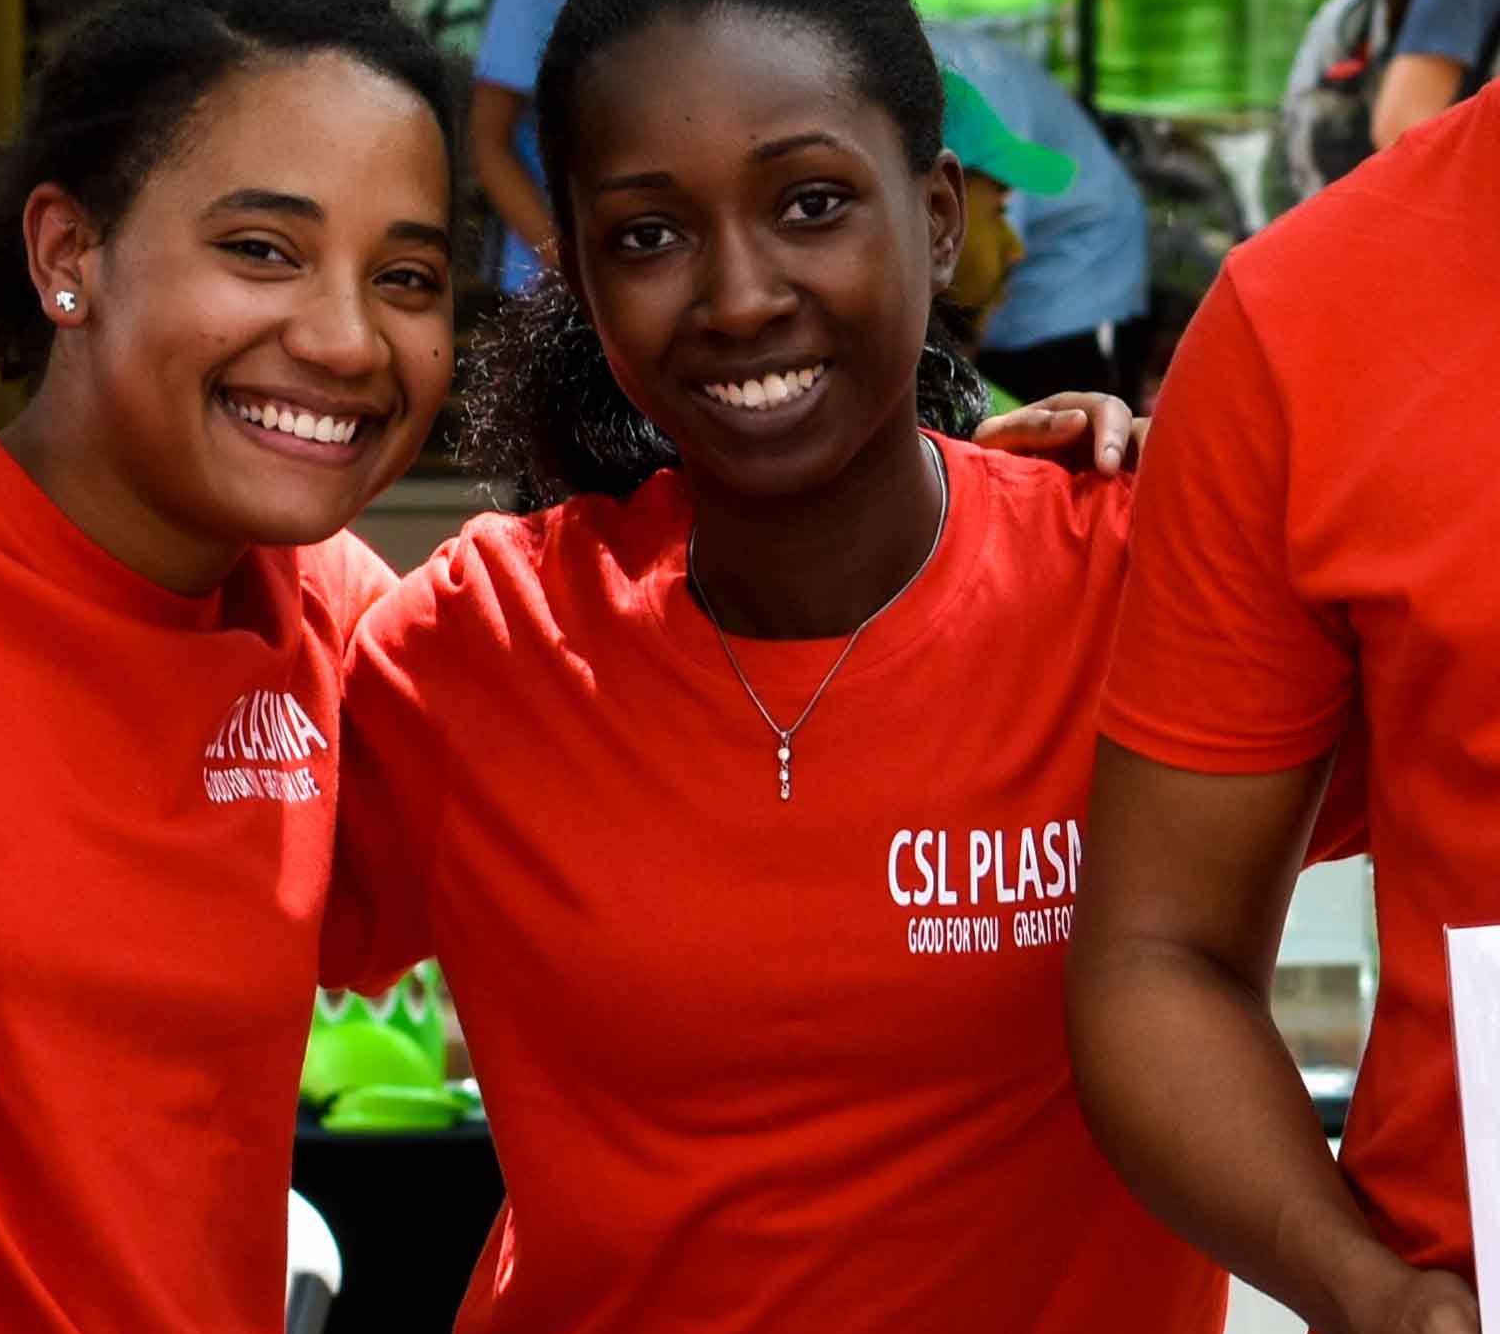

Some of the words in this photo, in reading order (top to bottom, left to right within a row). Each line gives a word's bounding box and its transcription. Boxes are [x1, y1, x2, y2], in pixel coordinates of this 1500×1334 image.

[888, 829, 957, 906] CSL
[908, 917, 944, 954] GOOD
[947, 917, 970, 952] FOR
[973, 917, 999, 951] YOU
[1014, 911, 1051, 947] GREAT
